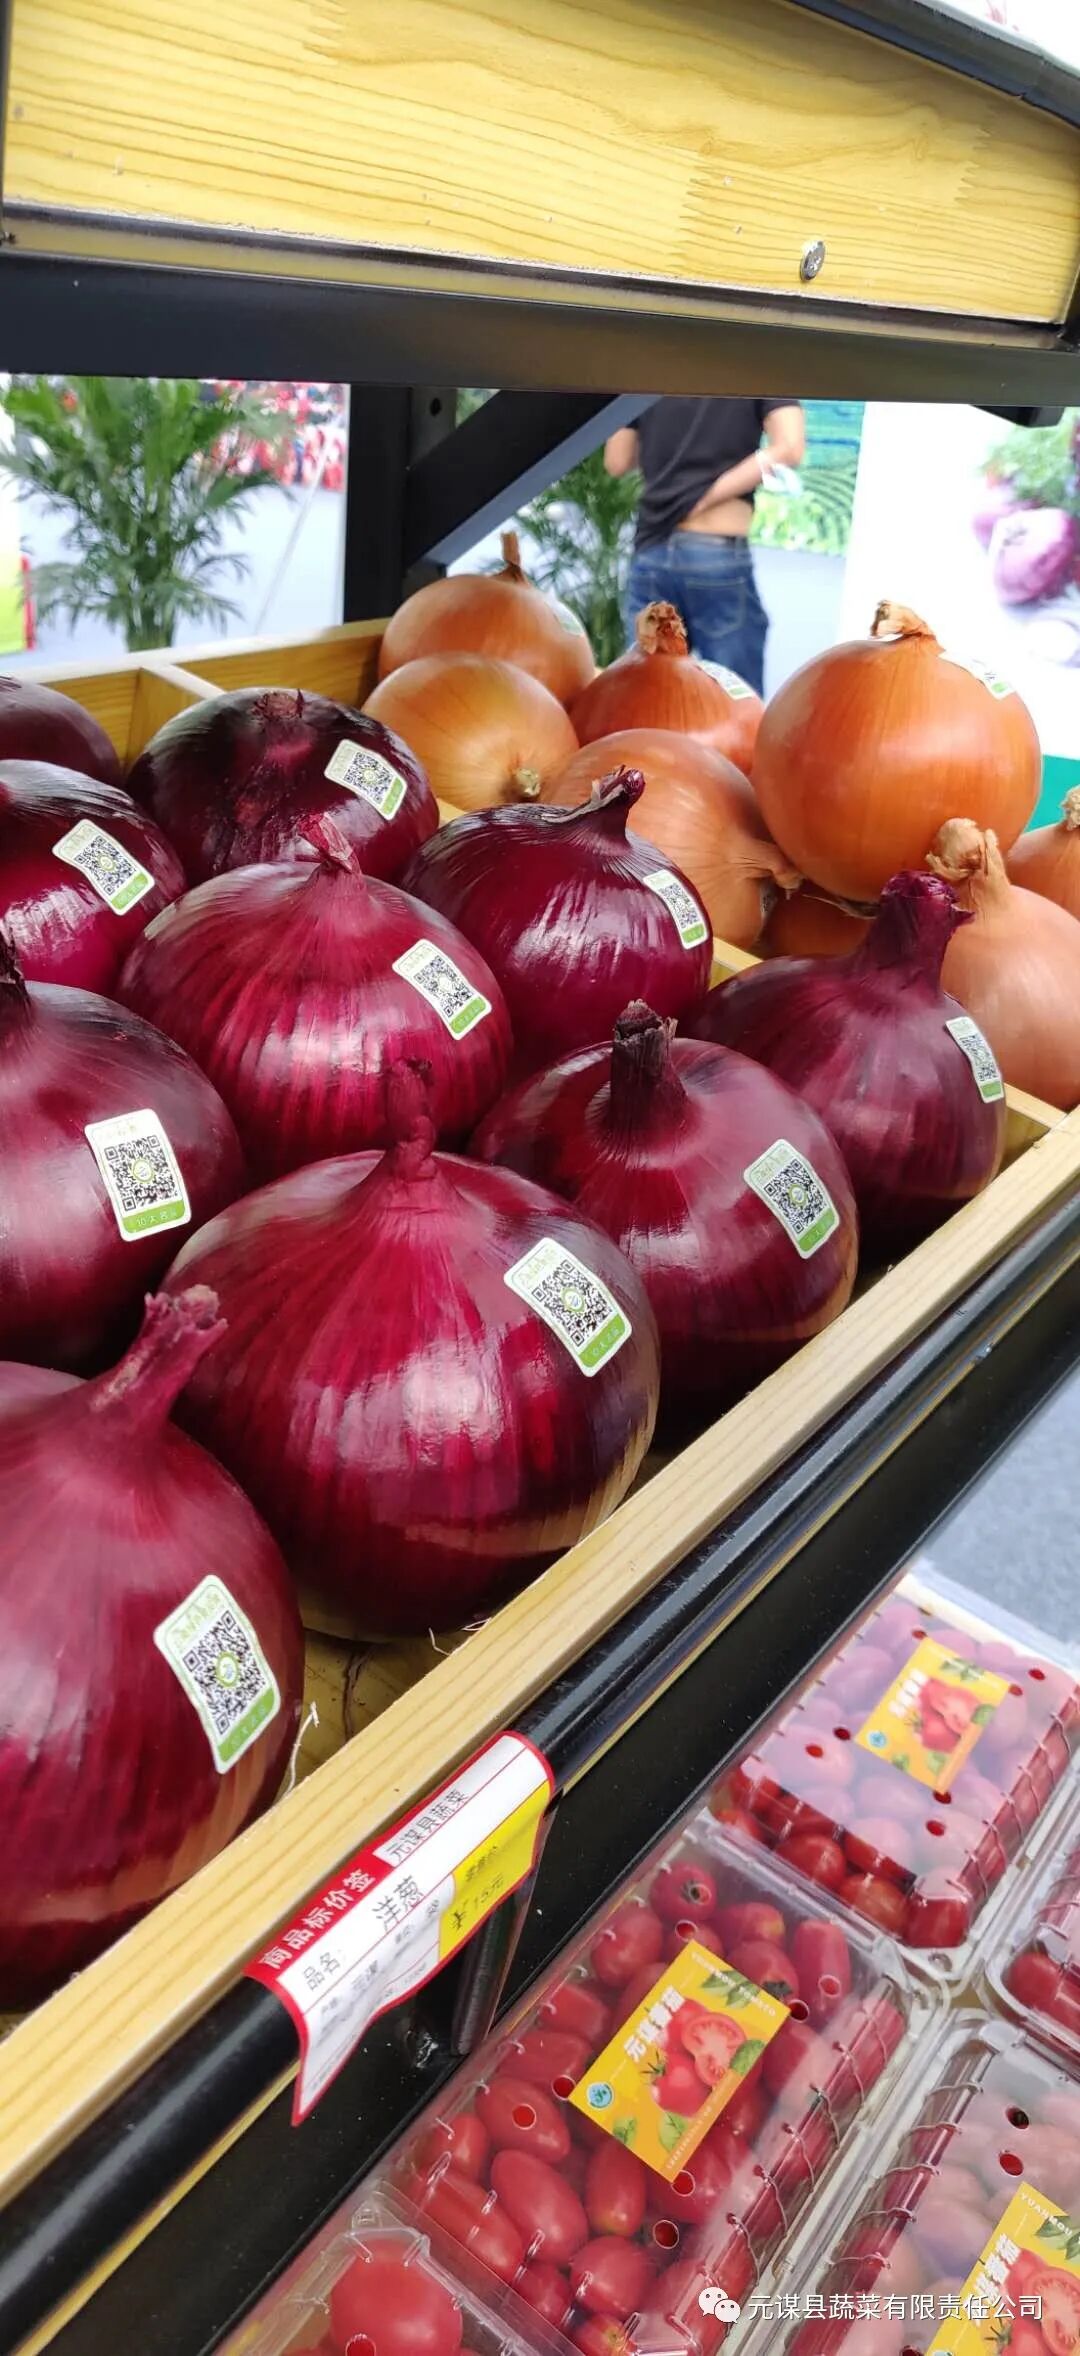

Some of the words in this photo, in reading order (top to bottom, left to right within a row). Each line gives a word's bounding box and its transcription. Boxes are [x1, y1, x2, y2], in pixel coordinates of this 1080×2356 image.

[387, 1788, 469, 1859] 元谋县蔬菜
[258, 1868, 376, 1970] 商品标价签
[375, 1874, 424, 1932] 洋葱
